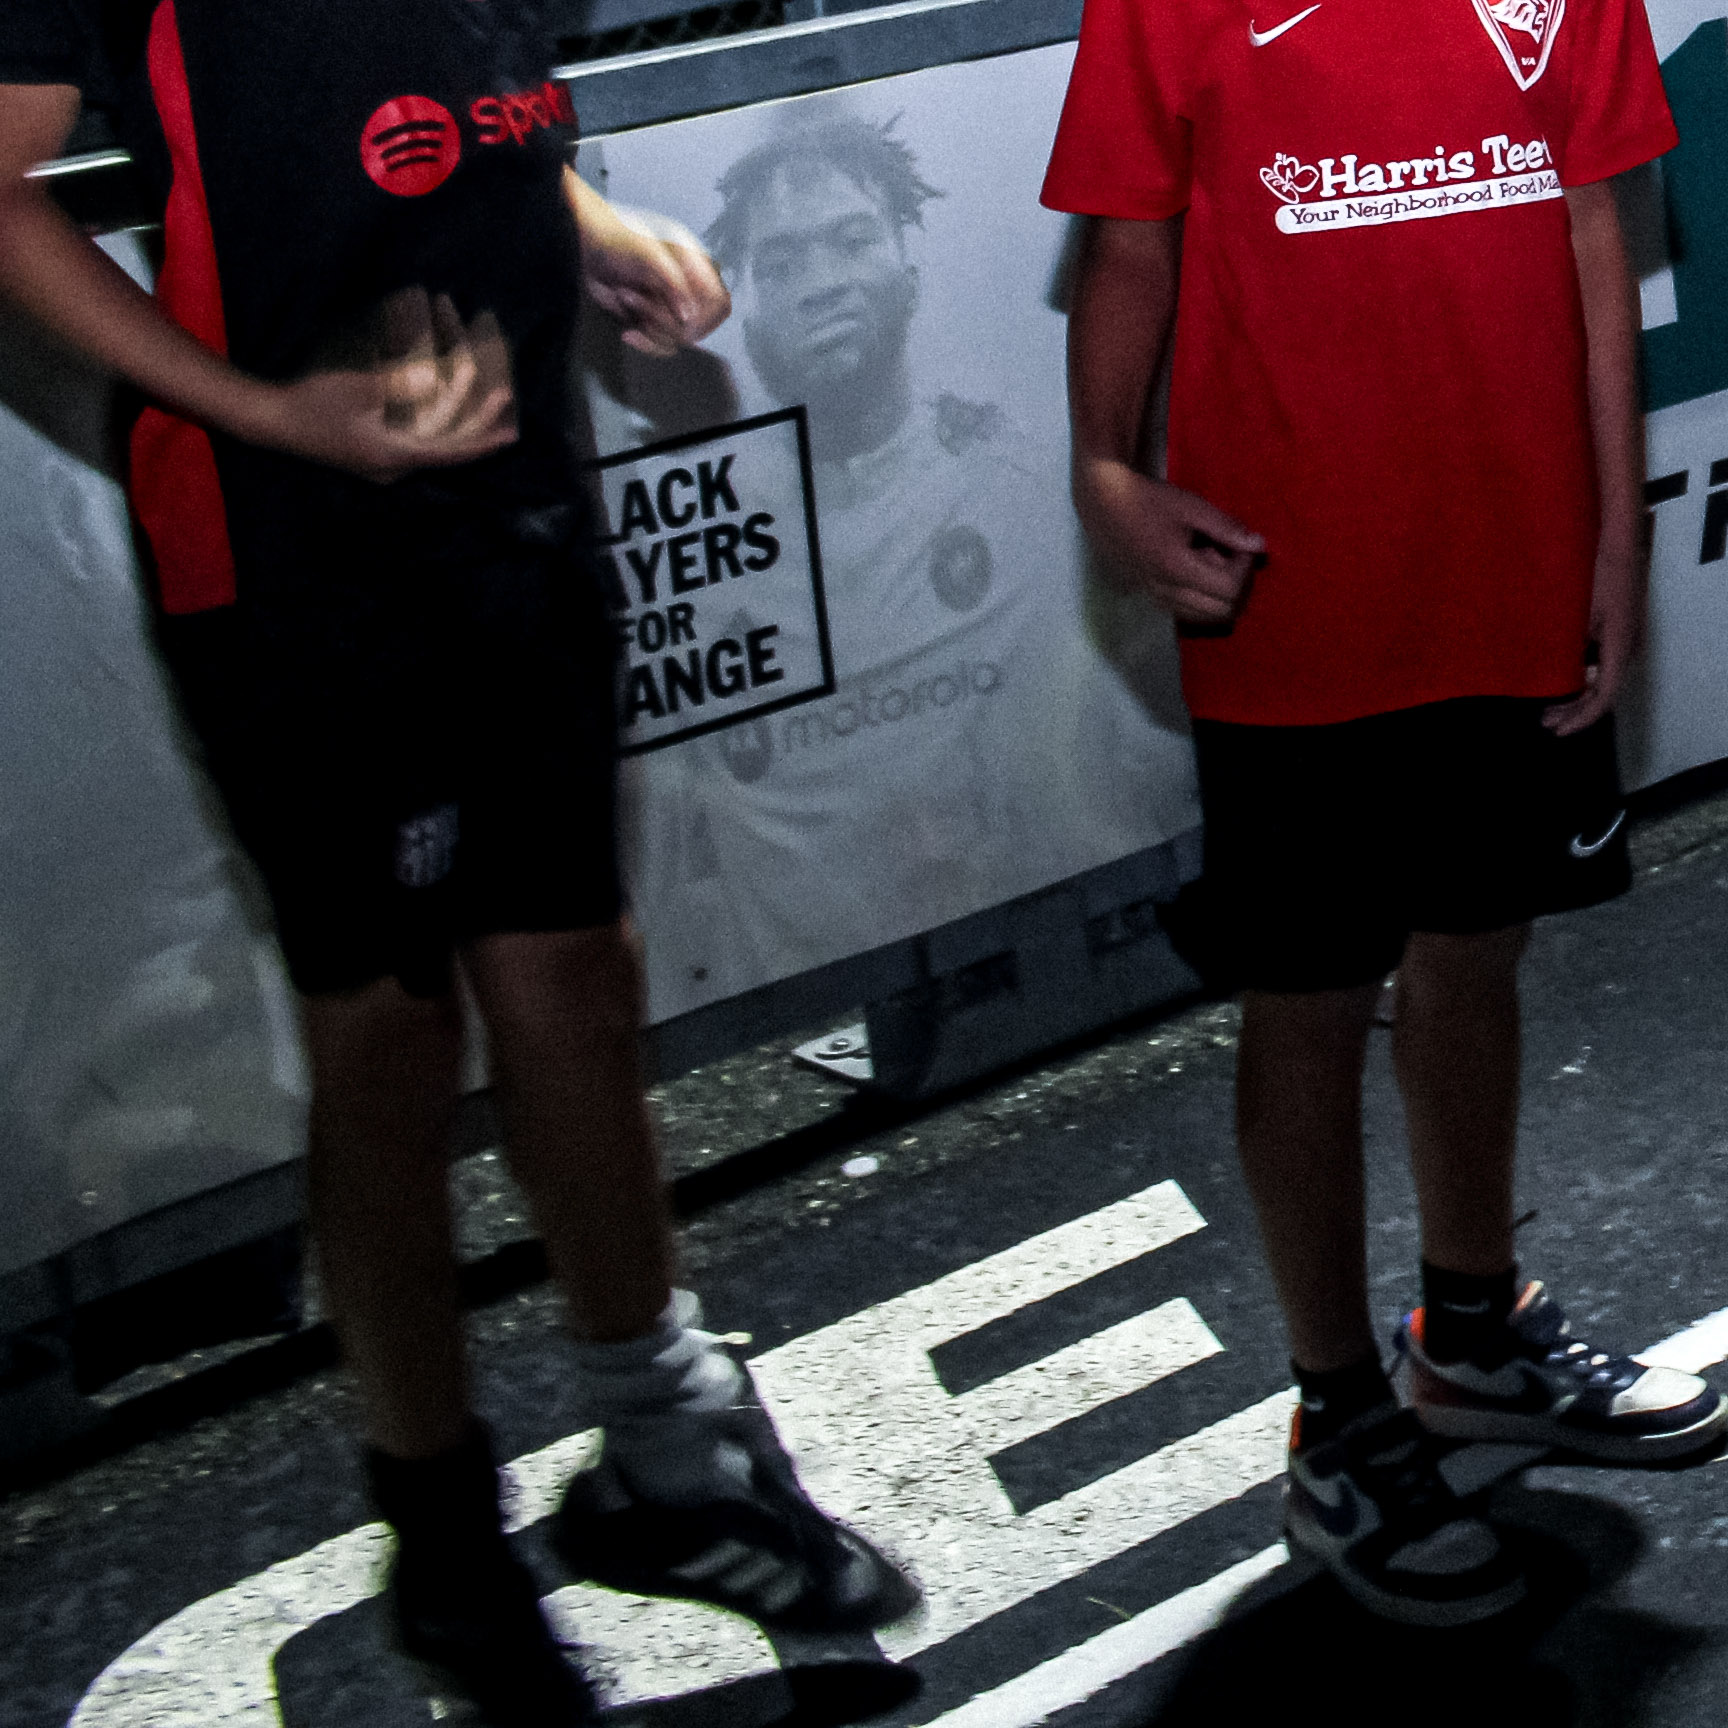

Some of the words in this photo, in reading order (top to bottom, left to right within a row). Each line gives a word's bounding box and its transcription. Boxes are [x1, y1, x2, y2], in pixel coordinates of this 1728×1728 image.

[470, 81, 572, 146] Spot
[1317, 145, 1476, 198] Harris
[1481, 133, 1552, 175] Tee
[1290, 207, 1340, 225] Your
[1346, 185, 1494, 219] Neighborhood
[1499, 177, 1537, 198] Food
[604, 454, 741, 543] ACK
[620, 624, 784, 727] ANGE
